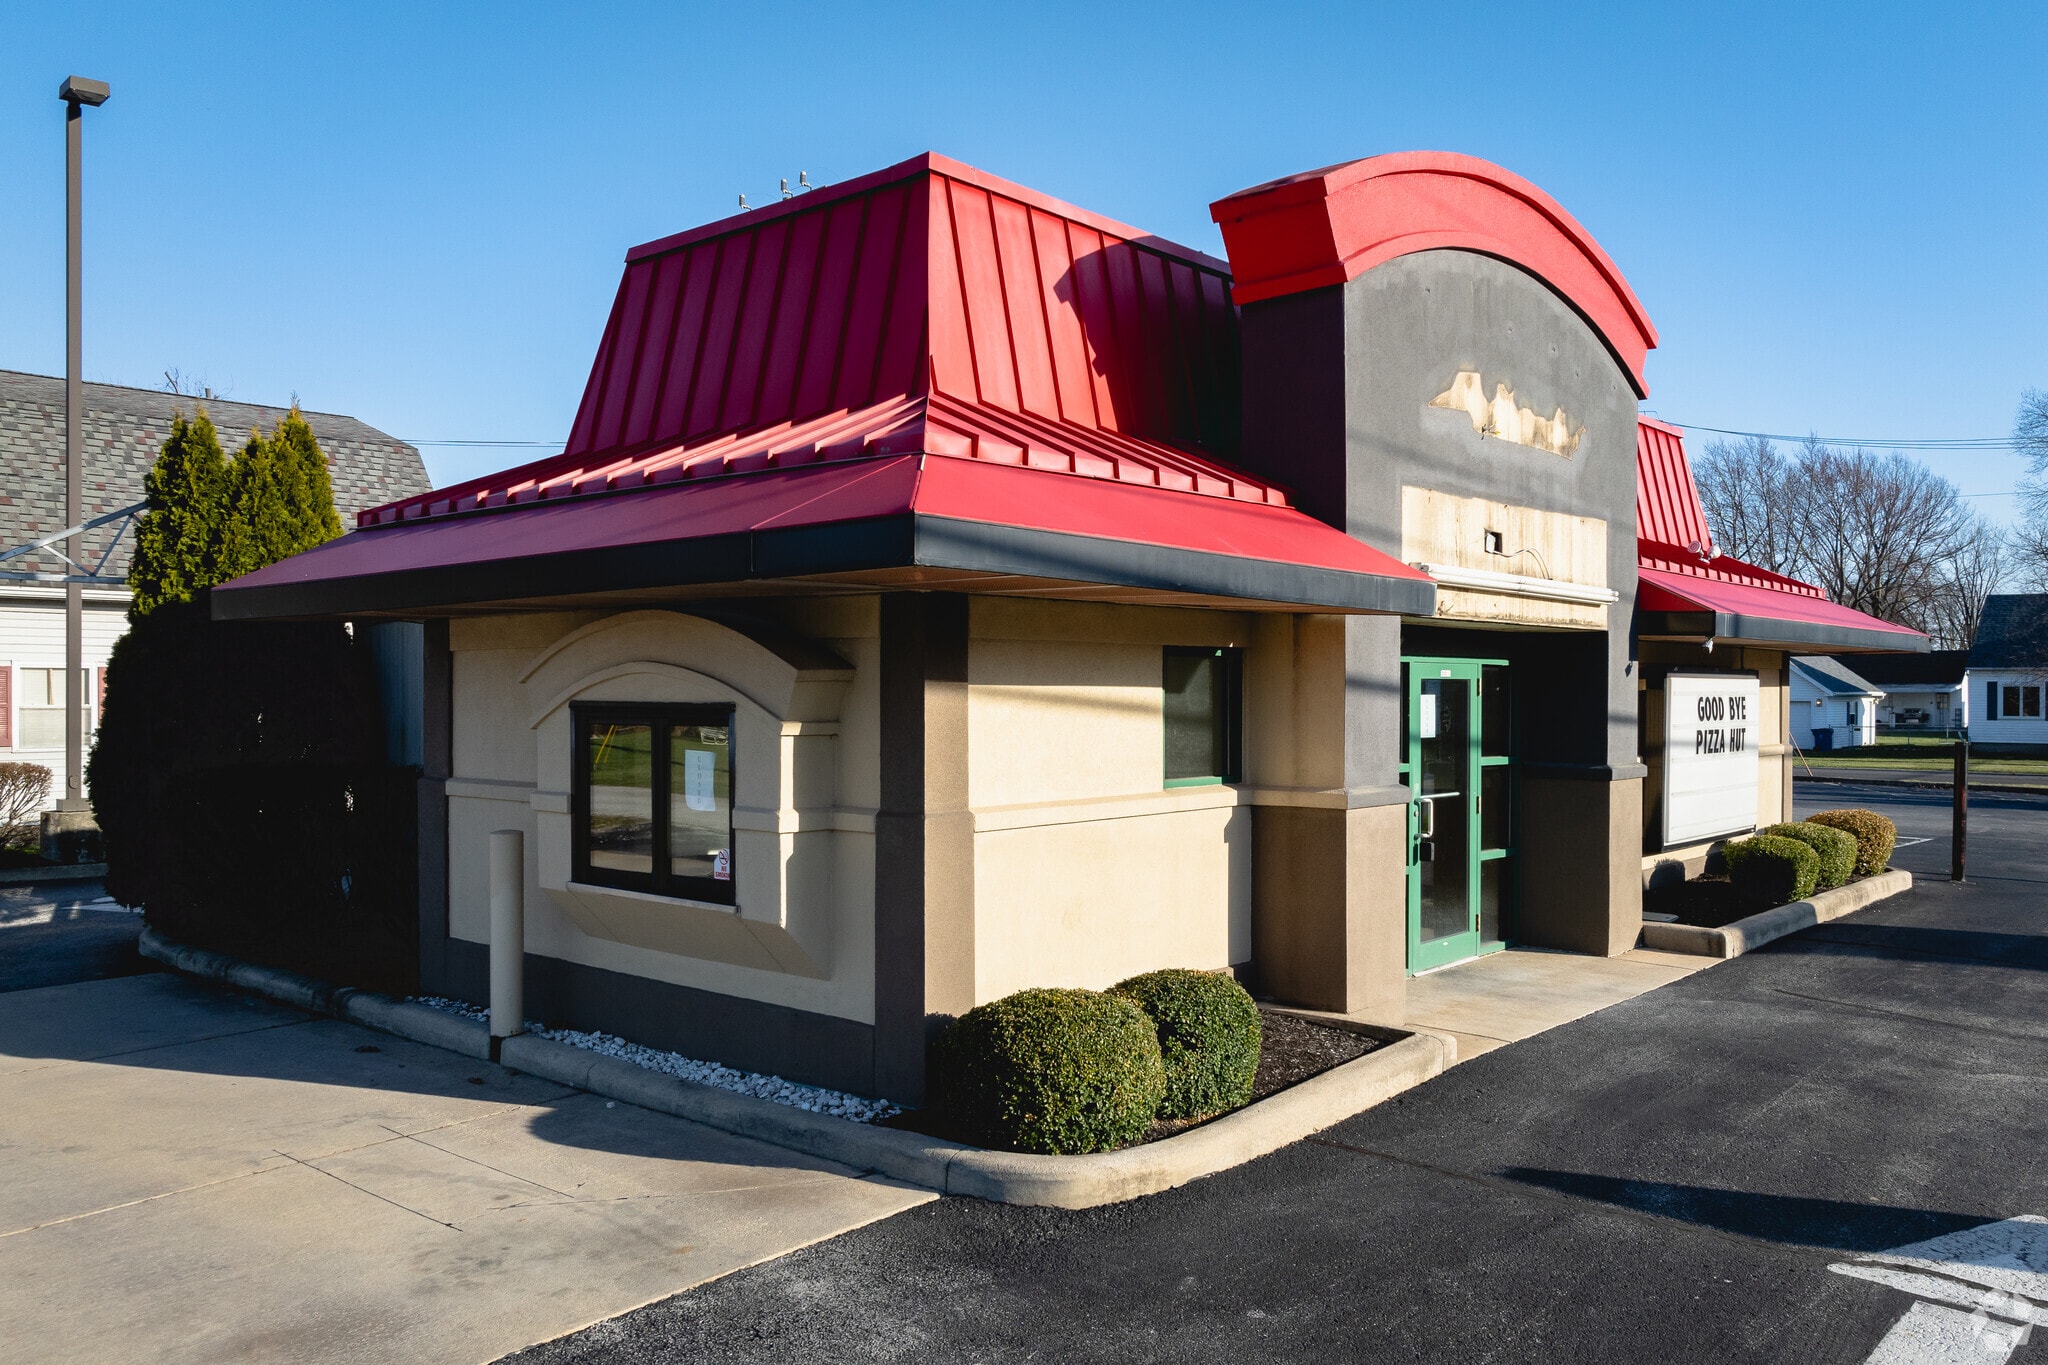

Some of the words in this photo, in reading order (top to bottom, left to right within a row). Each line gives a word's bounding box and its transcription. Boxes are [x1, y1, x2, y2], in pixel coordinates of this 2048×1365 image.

[1698, 696, 1724, 721] GOOD
[1729, 696, 1746, 720] BYE
[1696, 729, 1725, 754] PIZZA
[1729, 728, 1746, 752] HUT
